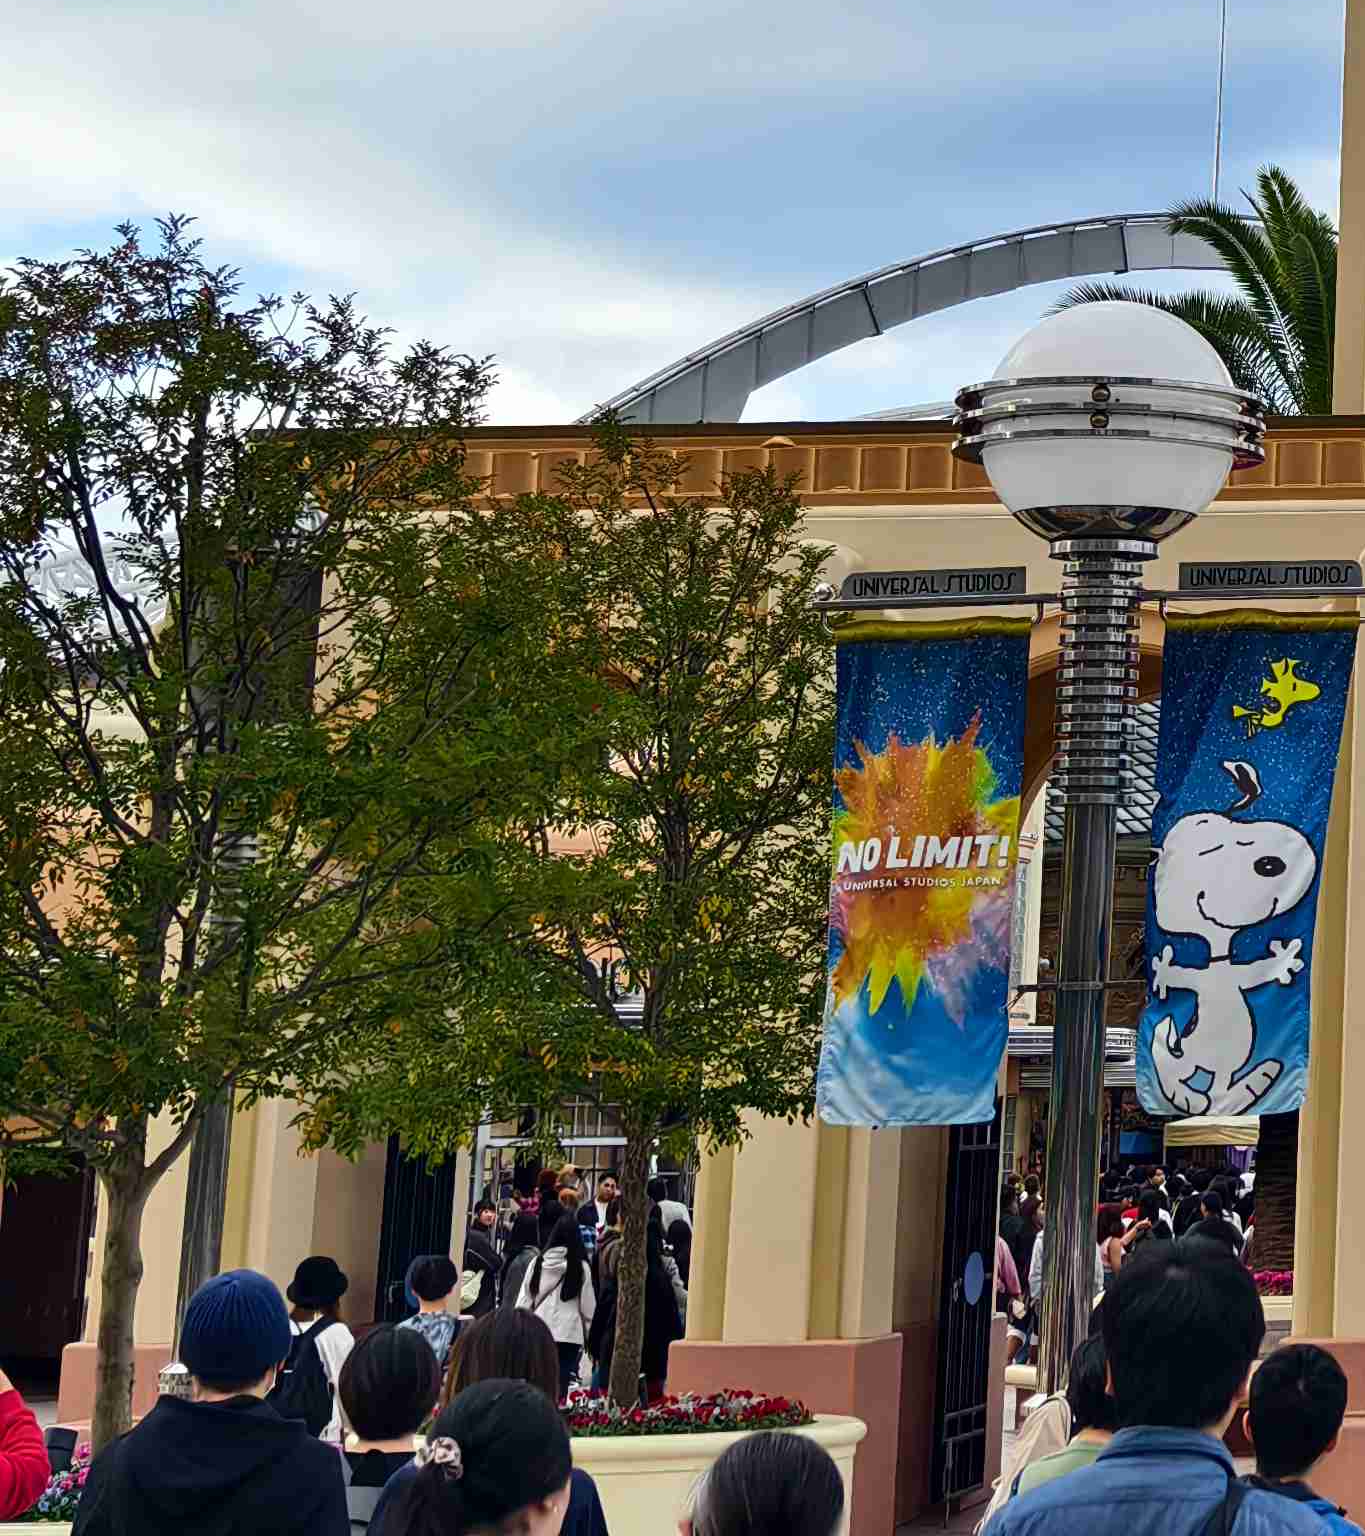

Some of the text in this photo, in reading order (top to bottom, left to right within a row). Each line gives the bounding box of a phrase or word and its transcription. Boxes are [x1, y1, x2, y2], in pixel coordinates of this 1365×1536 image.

[853, 571, 1017, 597] UNIVERSAL STUDIOS
[1190, 565, 1354, 586] UNIVERSAL STUDIOS
[836, 834, 1010, 873] NO LIMIT!
[843, 876, 1001, 891] UNIVERSAL STUDIOS JAPAN
